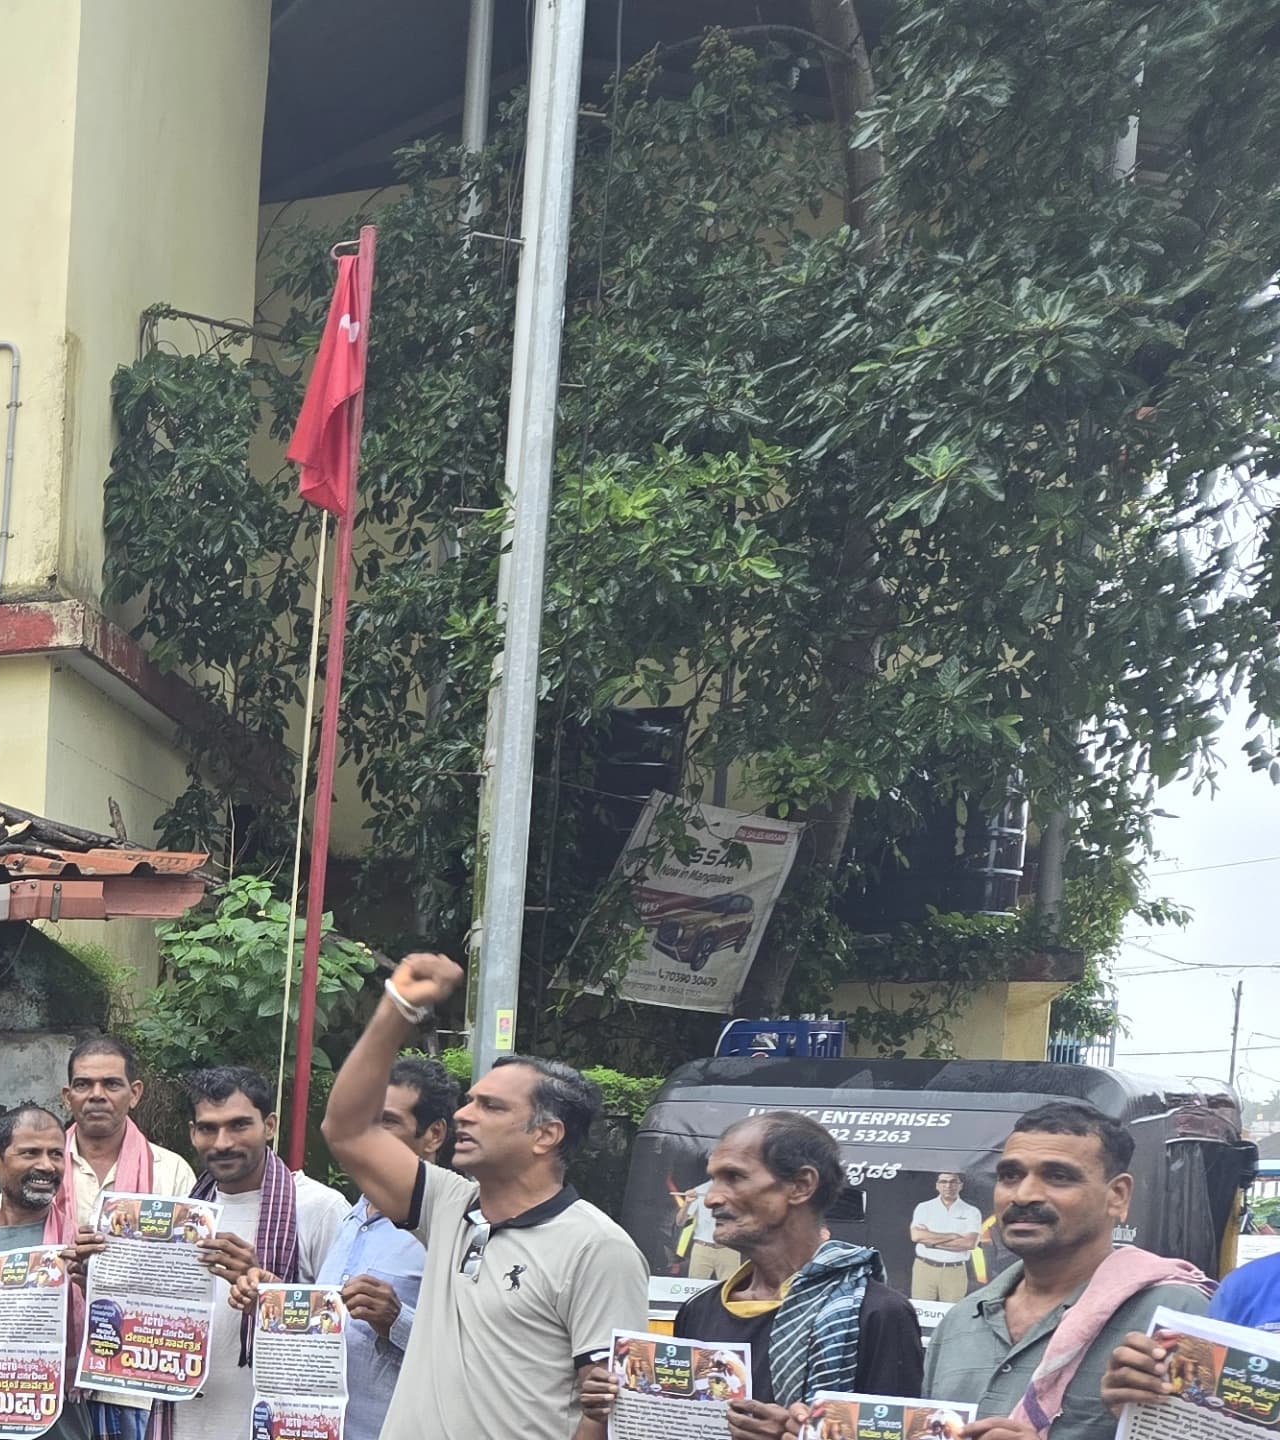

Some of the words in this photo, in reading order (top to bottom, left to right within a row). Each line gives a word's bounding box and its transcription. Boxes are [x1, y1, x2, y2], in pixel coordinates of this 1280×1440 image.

[660, 864, 679, 878] Now
[679, 868, 689, 879] in
[690, 867, 734, 886] Mangalore
[820, 1111, 953, 1127] ENTERPRISES
[852, 1129, 912, 1144] 53263
[666, 1346, 677, 1357] 9
[121, 1345, 202, 1380] ಮುಷ್ಕರ
[1248, 1356, 1269, 1371] 9
[874, 1406, 888, 1418] 9
